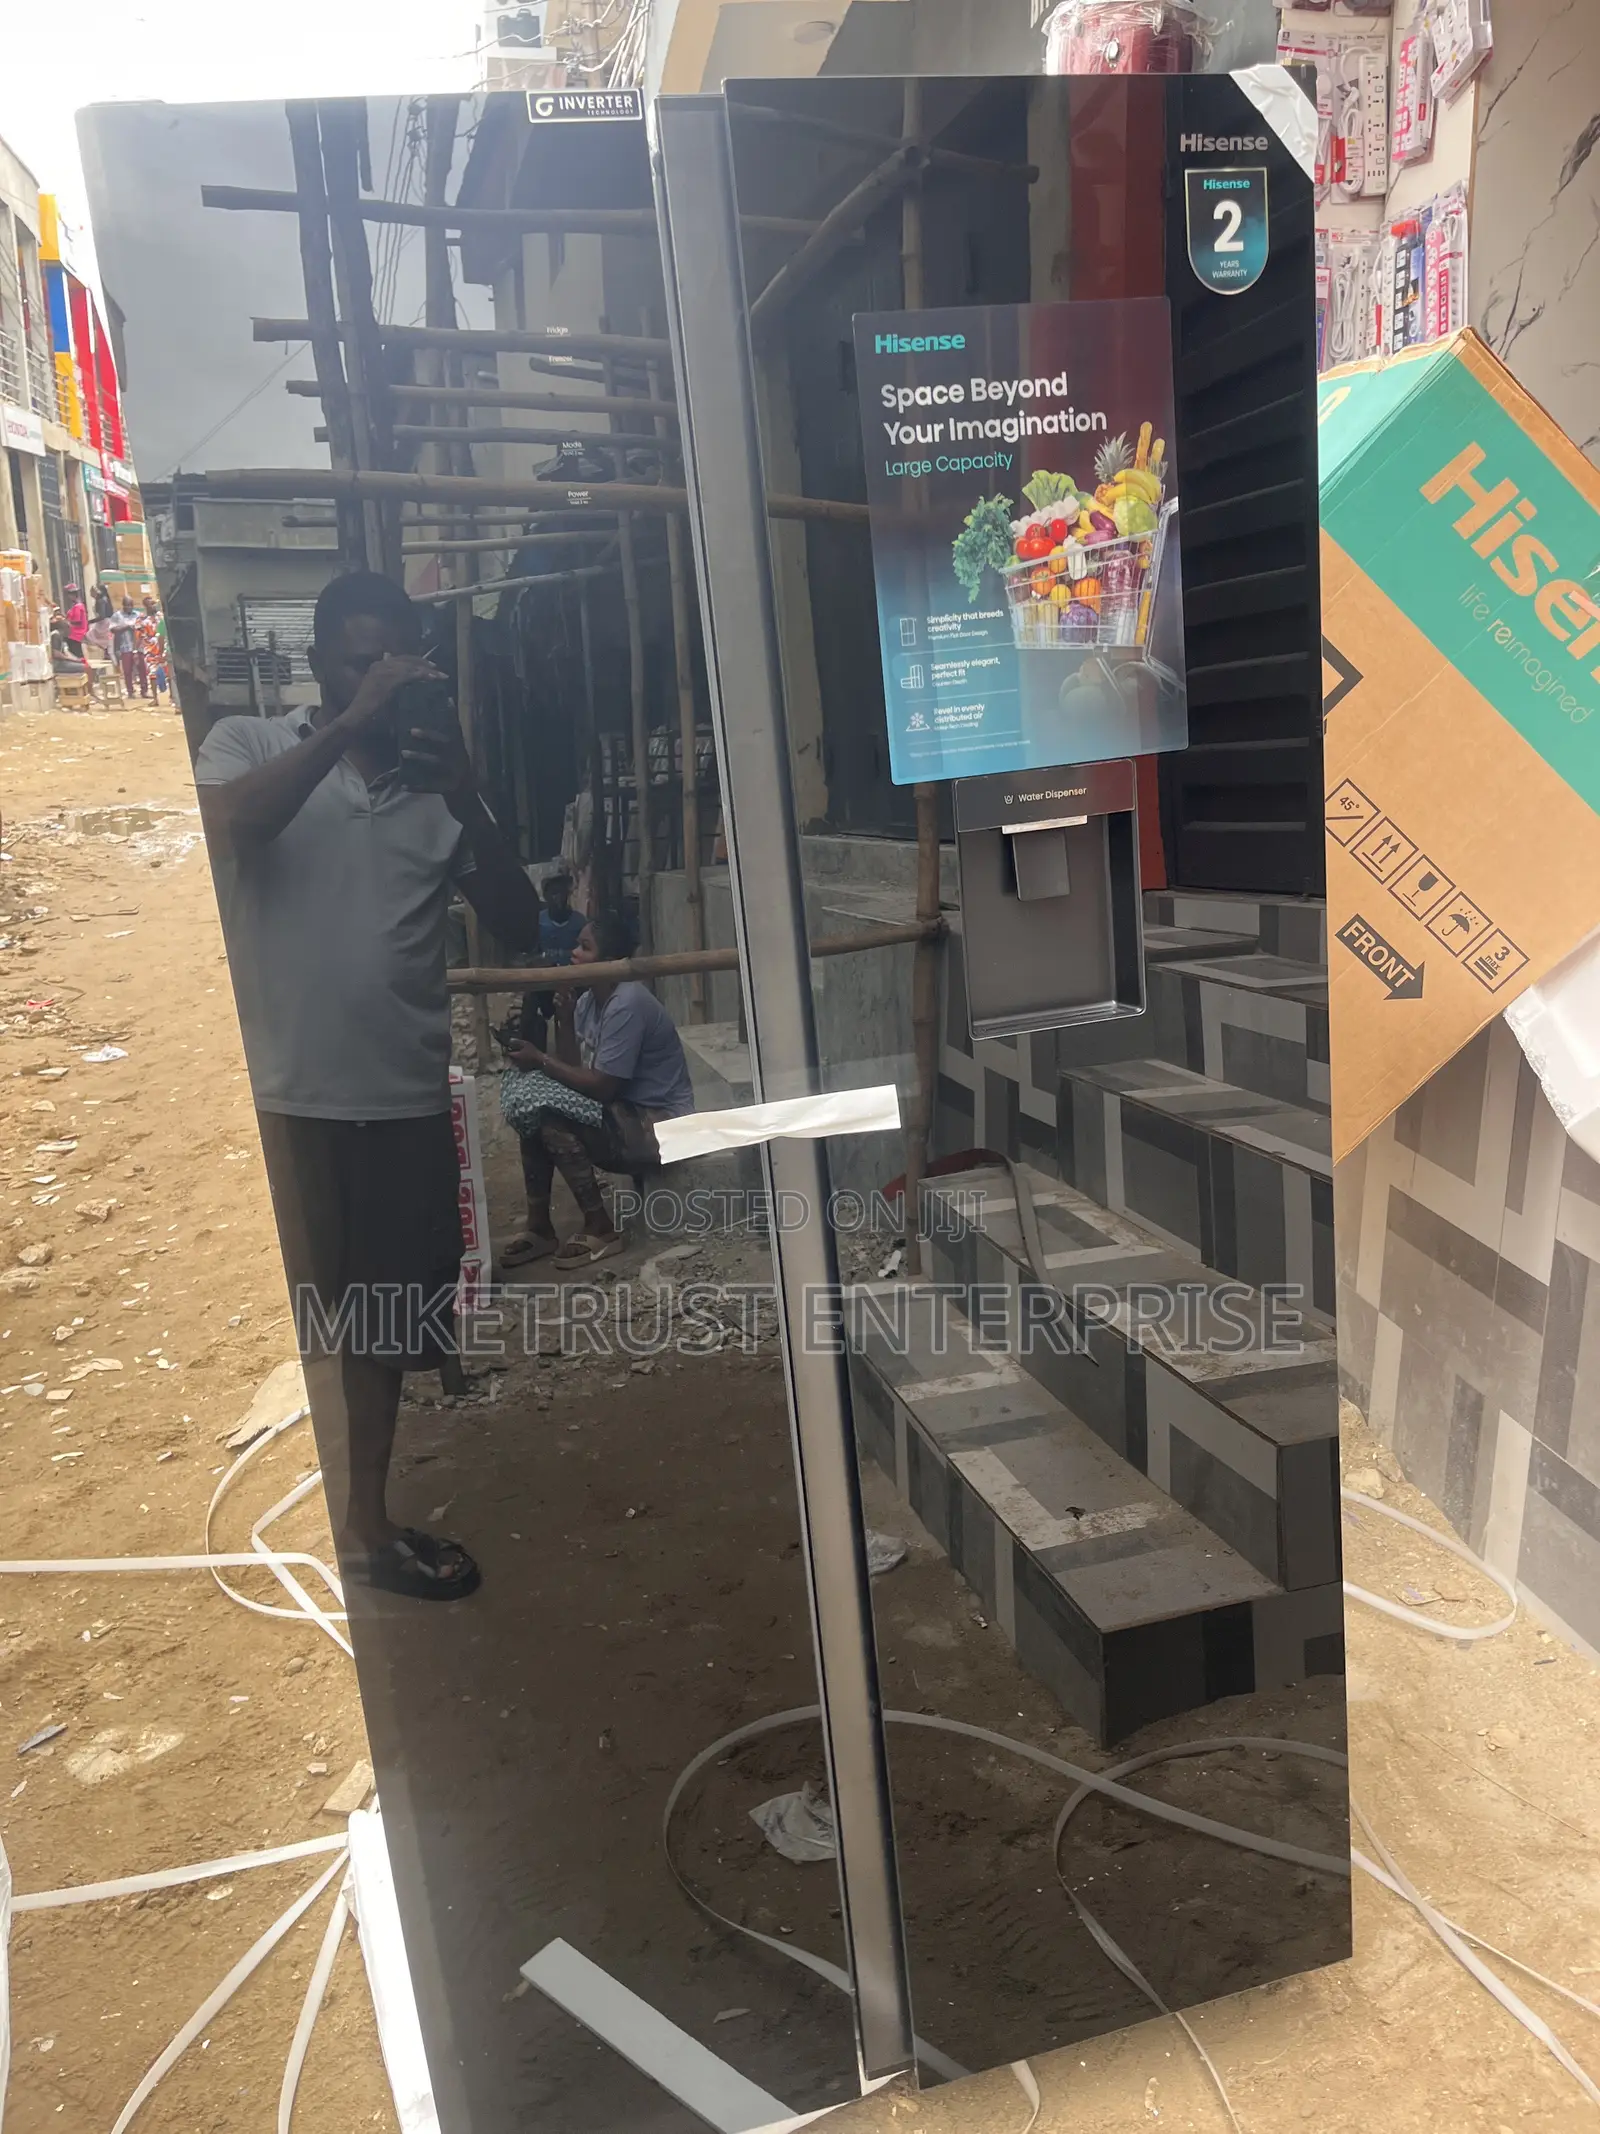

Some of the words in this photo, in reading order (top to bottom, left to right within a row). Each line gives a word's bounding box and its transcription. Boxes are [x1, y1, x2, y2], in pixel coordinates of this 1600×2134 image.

[558, 95, 633, 110] INVERTER
[1180, 133, 1269, 152] Hisense
[1203, 179, 1251, 190] Hisense
[1213, 200, 1244, 252] 2
[1219, 260, 1240, 268] YEARS
[1212, 269, 1247, 279] WARRANTY
[875, 333, 966, 354] Hisense
[881, 384, 965, 413] Space
[970, 371, 1068, 406] Beyond
[883, 421, 944, 445] Your
[949, 407, 1107, 443] Imagination
[562, 441, 583, 449] Mode
[885, 458, 932, 479] Large
[936, 451, 1013, 474] Capacity
[567, 490, 589, 498] Power
[963, 612, 979, 620] that
[979, 609, 1004, 619] breeds
[928, 623, 961, 632] creativity
[1458, 582, 1490, 621] life
[1487, 618, 1595, 723] reimagined
[931, 660, 970, 670] Seamlessly
[932, 670, 957, 680] perfect
[954, 705, 960, 713] in
[961, 703, 985, 712] evenly
[934, 713, 972, 724] distributed
[973, 711, 983, 719] air
[1018, 791, 1044, 803] Water
[1045, 787, 1087, 800] Dispenser
[1342, 920, 1415, 988] FRONT
[1494, 946, 1511, 961] 3
[1485, 955, 1502, 970] max
